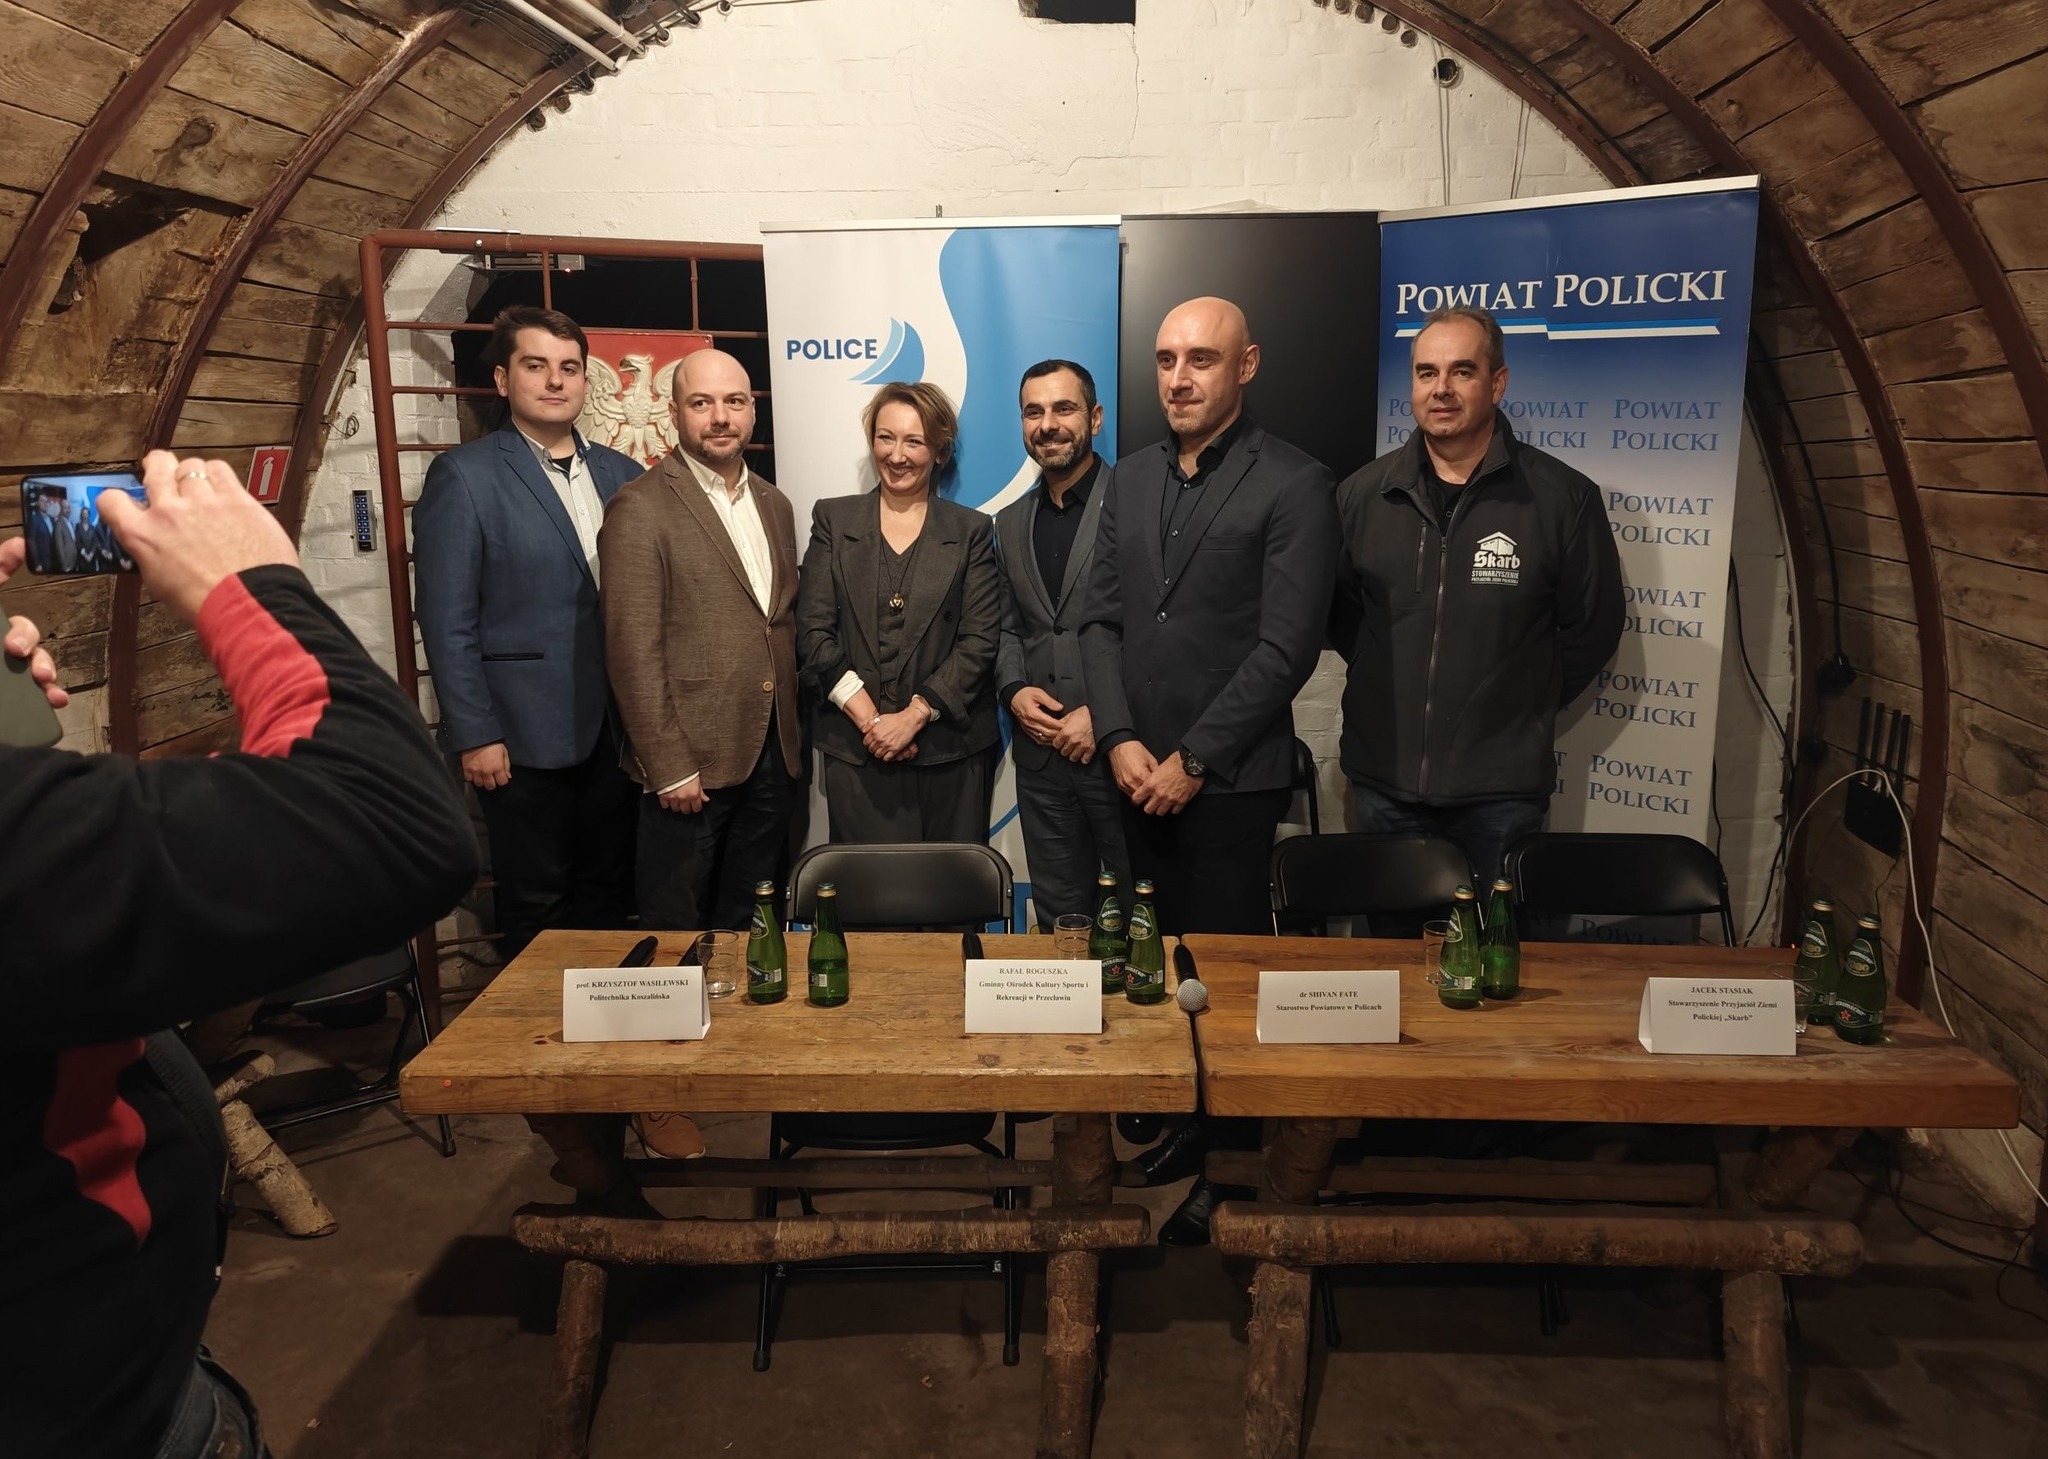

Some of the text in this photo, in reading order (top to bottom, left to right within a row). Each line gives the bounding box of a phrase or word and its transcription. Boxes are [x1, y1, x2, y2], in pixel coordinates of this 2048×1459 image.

[1396, 270, 1727, 314] POWIAT POLICKI
[787, 339, 877, 360] POLICE
[1613, 399, 1721, 420] POWIAT
[1611, 429, 1719, 451] POLICKI
[1608, 491, 1713, 515] POWIAT
[1473, 550, 1521, 569] Skarb
[1623, 586, 1706, 608] OWIAT
[1596, 670, 1699, 698] POWIAT
[1594, 697, 1696, 728] POLICKI
[1591, 754, 1692, 786] POWIAT
[1588, 782, 1690, 815] POLICKI
[639, 979, 689, 987] WASILEWSKI
[979, 981, 1004, 989] Gminny
[1035, 981, 1060, 989] Kultury
[1062, 981, 1084, 989] Sportu
[996, 994, 1027, 1002] Rekreacji
[1668, 1000, 1719, 1008] Stowarzyszenie
[1721, 1001, 1756, 1009] Przyjaciół
[1693, 1013, 1722, 1021] Polickiej
